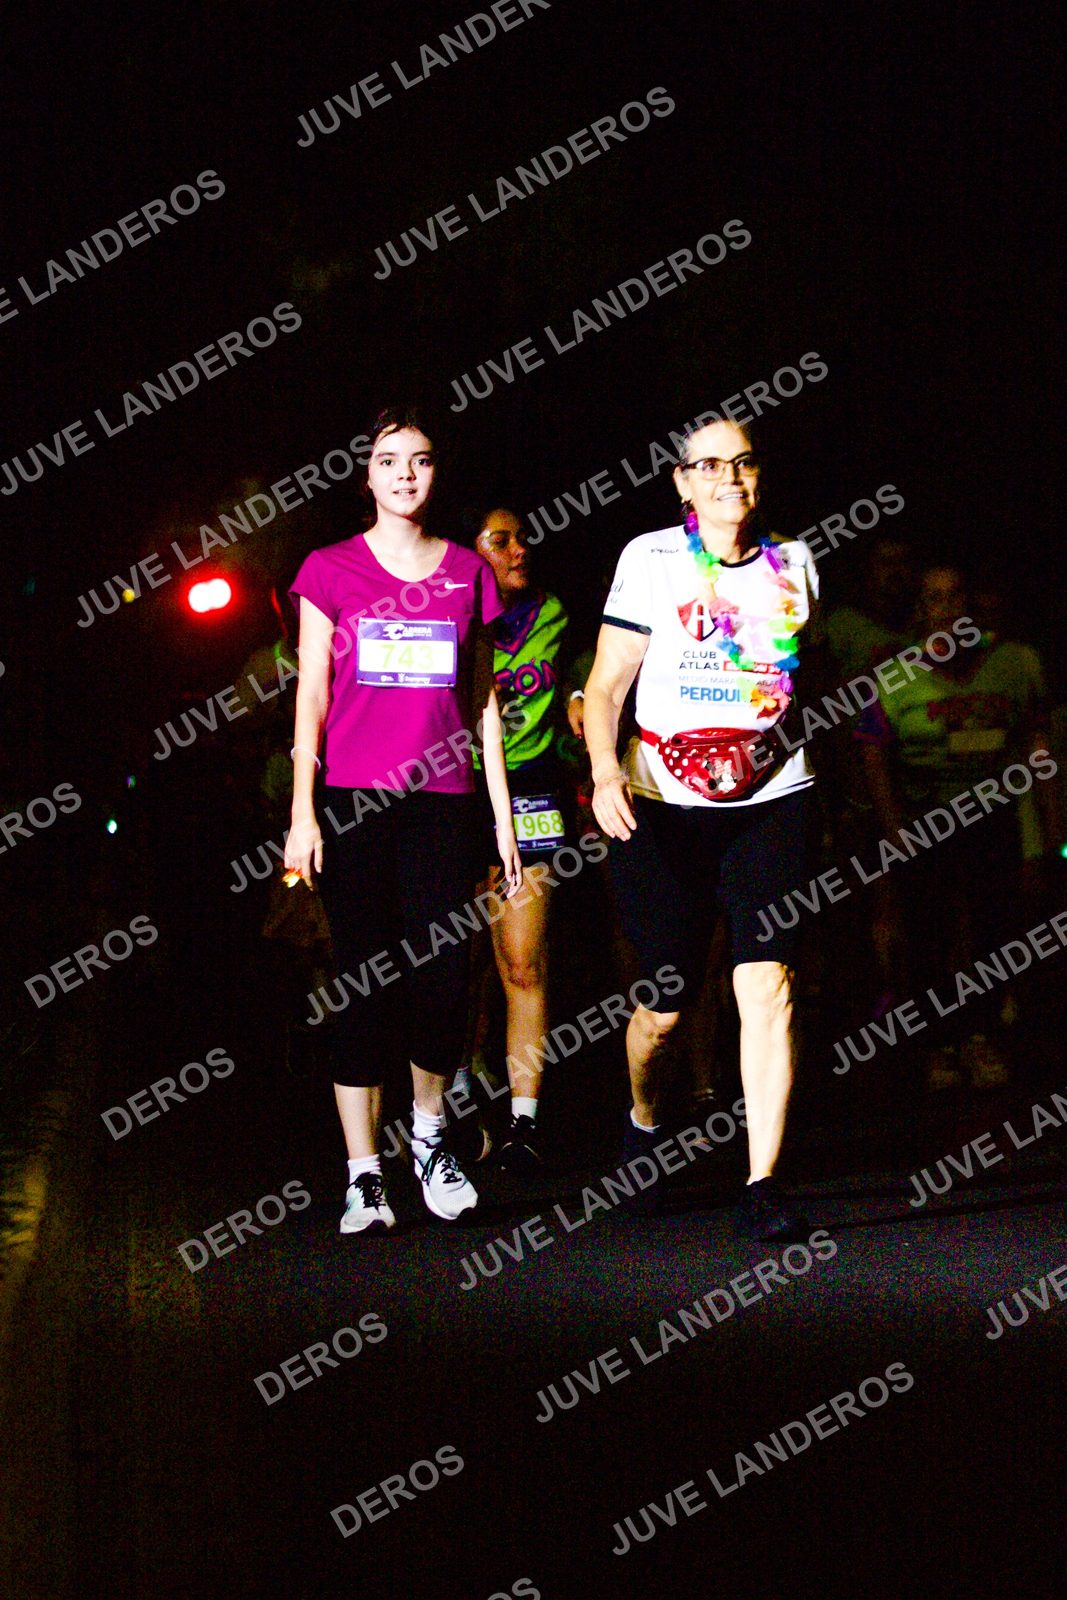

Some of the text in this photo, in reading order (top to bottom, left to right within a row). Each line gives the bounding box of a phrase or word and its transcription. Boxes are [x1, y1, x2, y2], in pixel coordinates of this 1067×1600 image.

[379, 644, 433, 670] 743
[683, 650, 717, 660] CLUB
[679, 661, 720, 670] ATLAS
